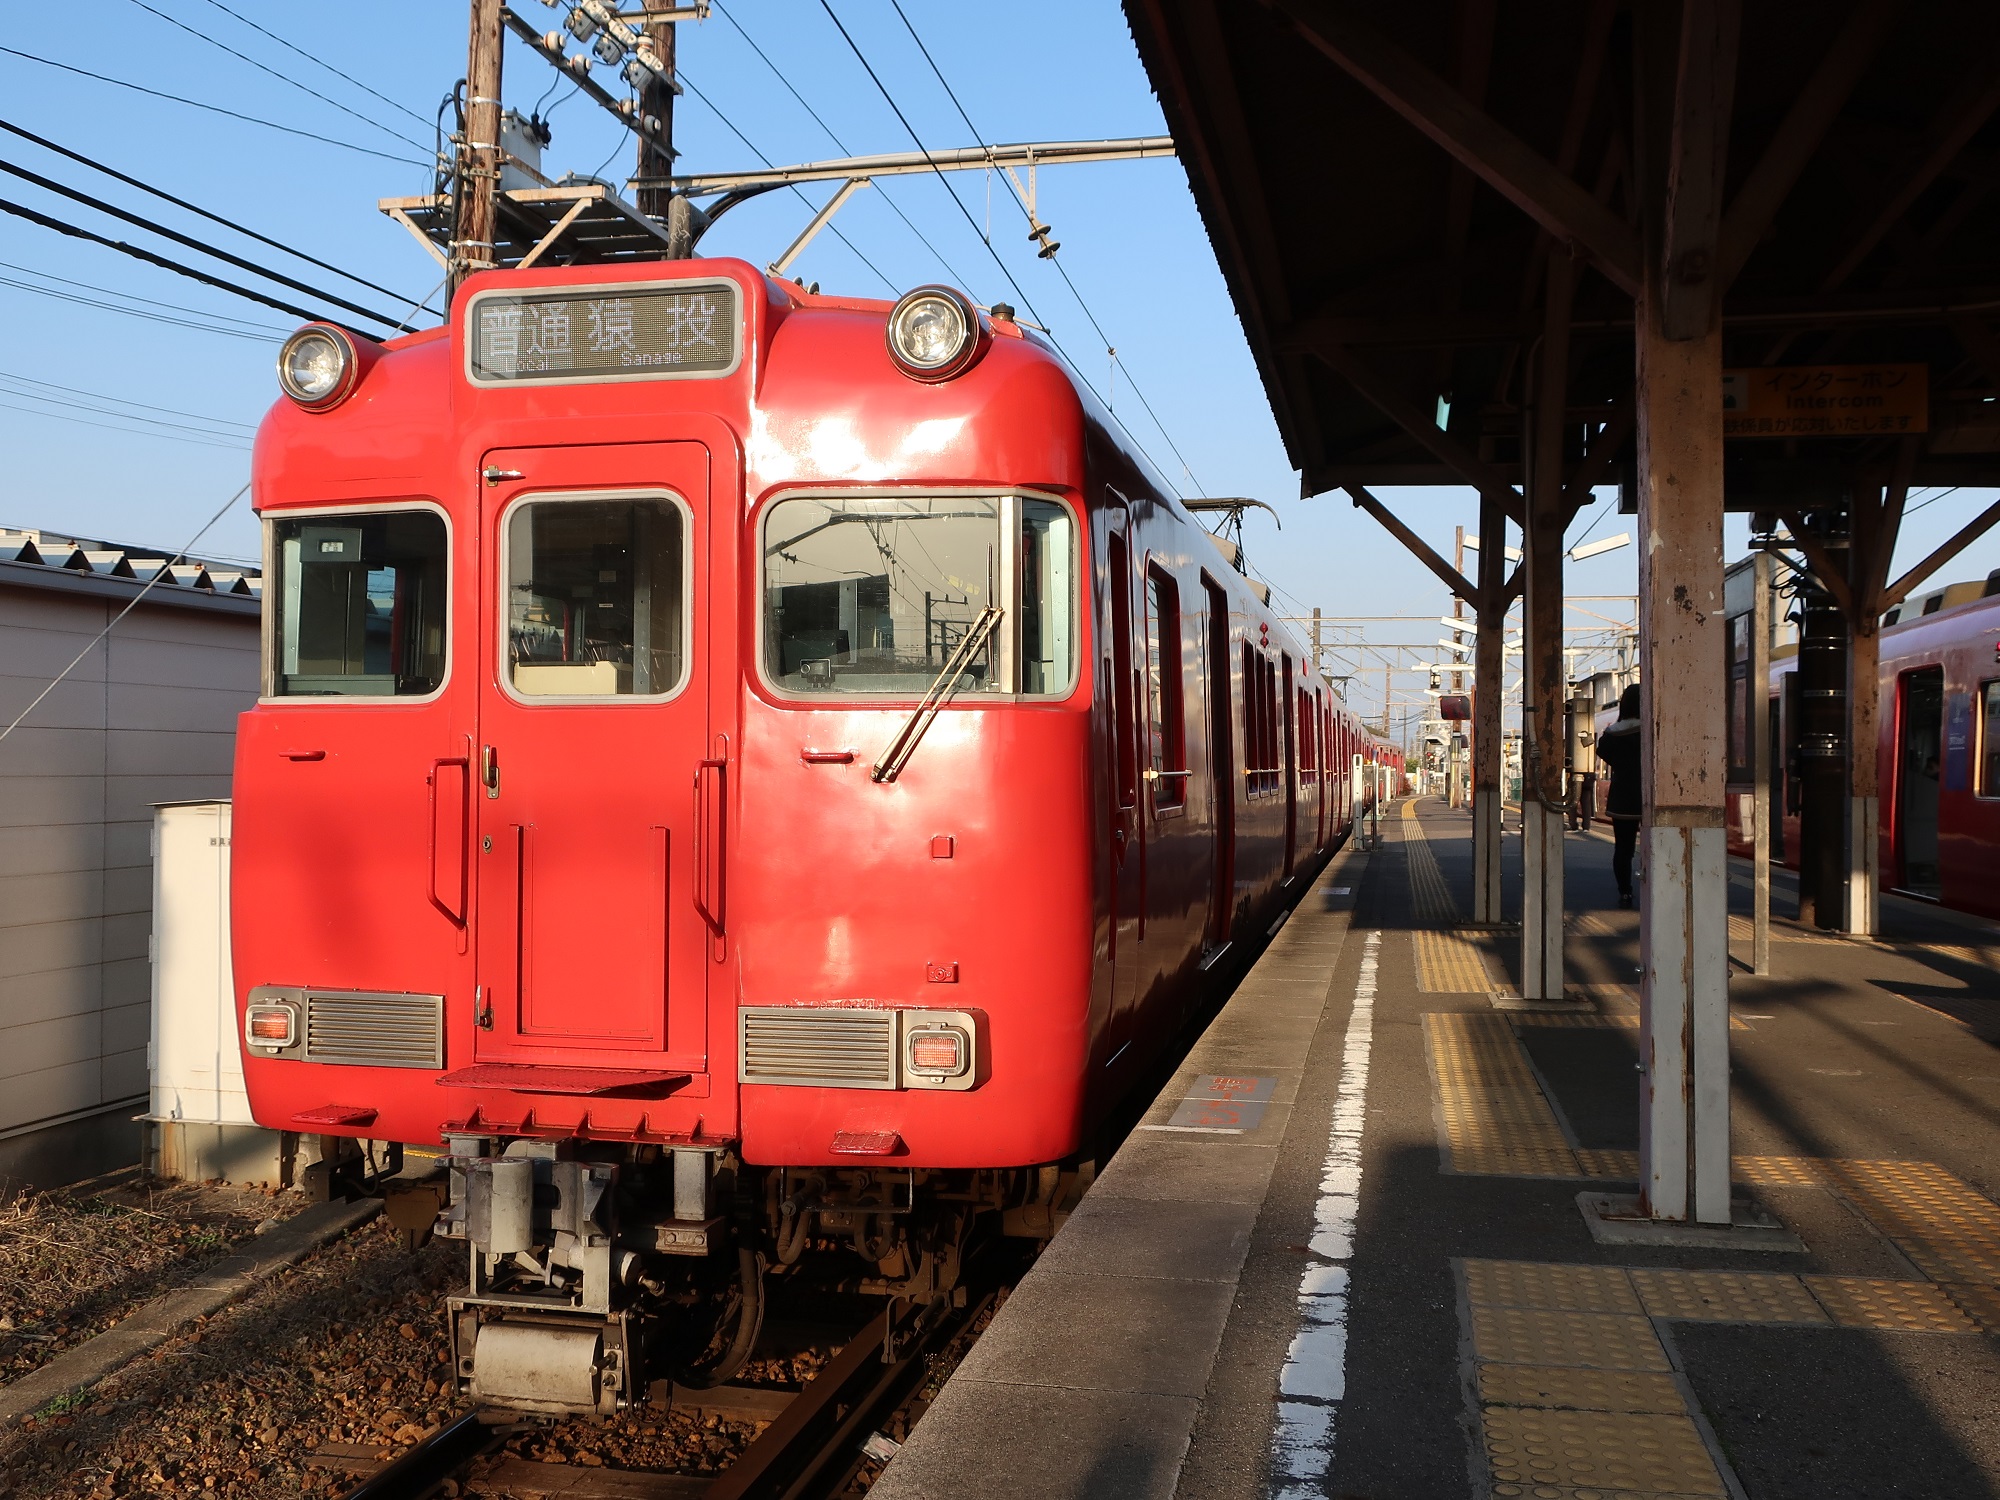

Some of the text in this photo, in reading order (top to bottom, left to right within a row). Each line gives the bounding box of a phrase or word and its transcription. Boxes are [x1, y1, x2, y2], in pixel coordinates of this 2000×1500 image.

[621, 349, 682, 367] Sanage
[1765, 369, 1908, 392] インターホン
[1786, 394, 1883, 409] Intercom
